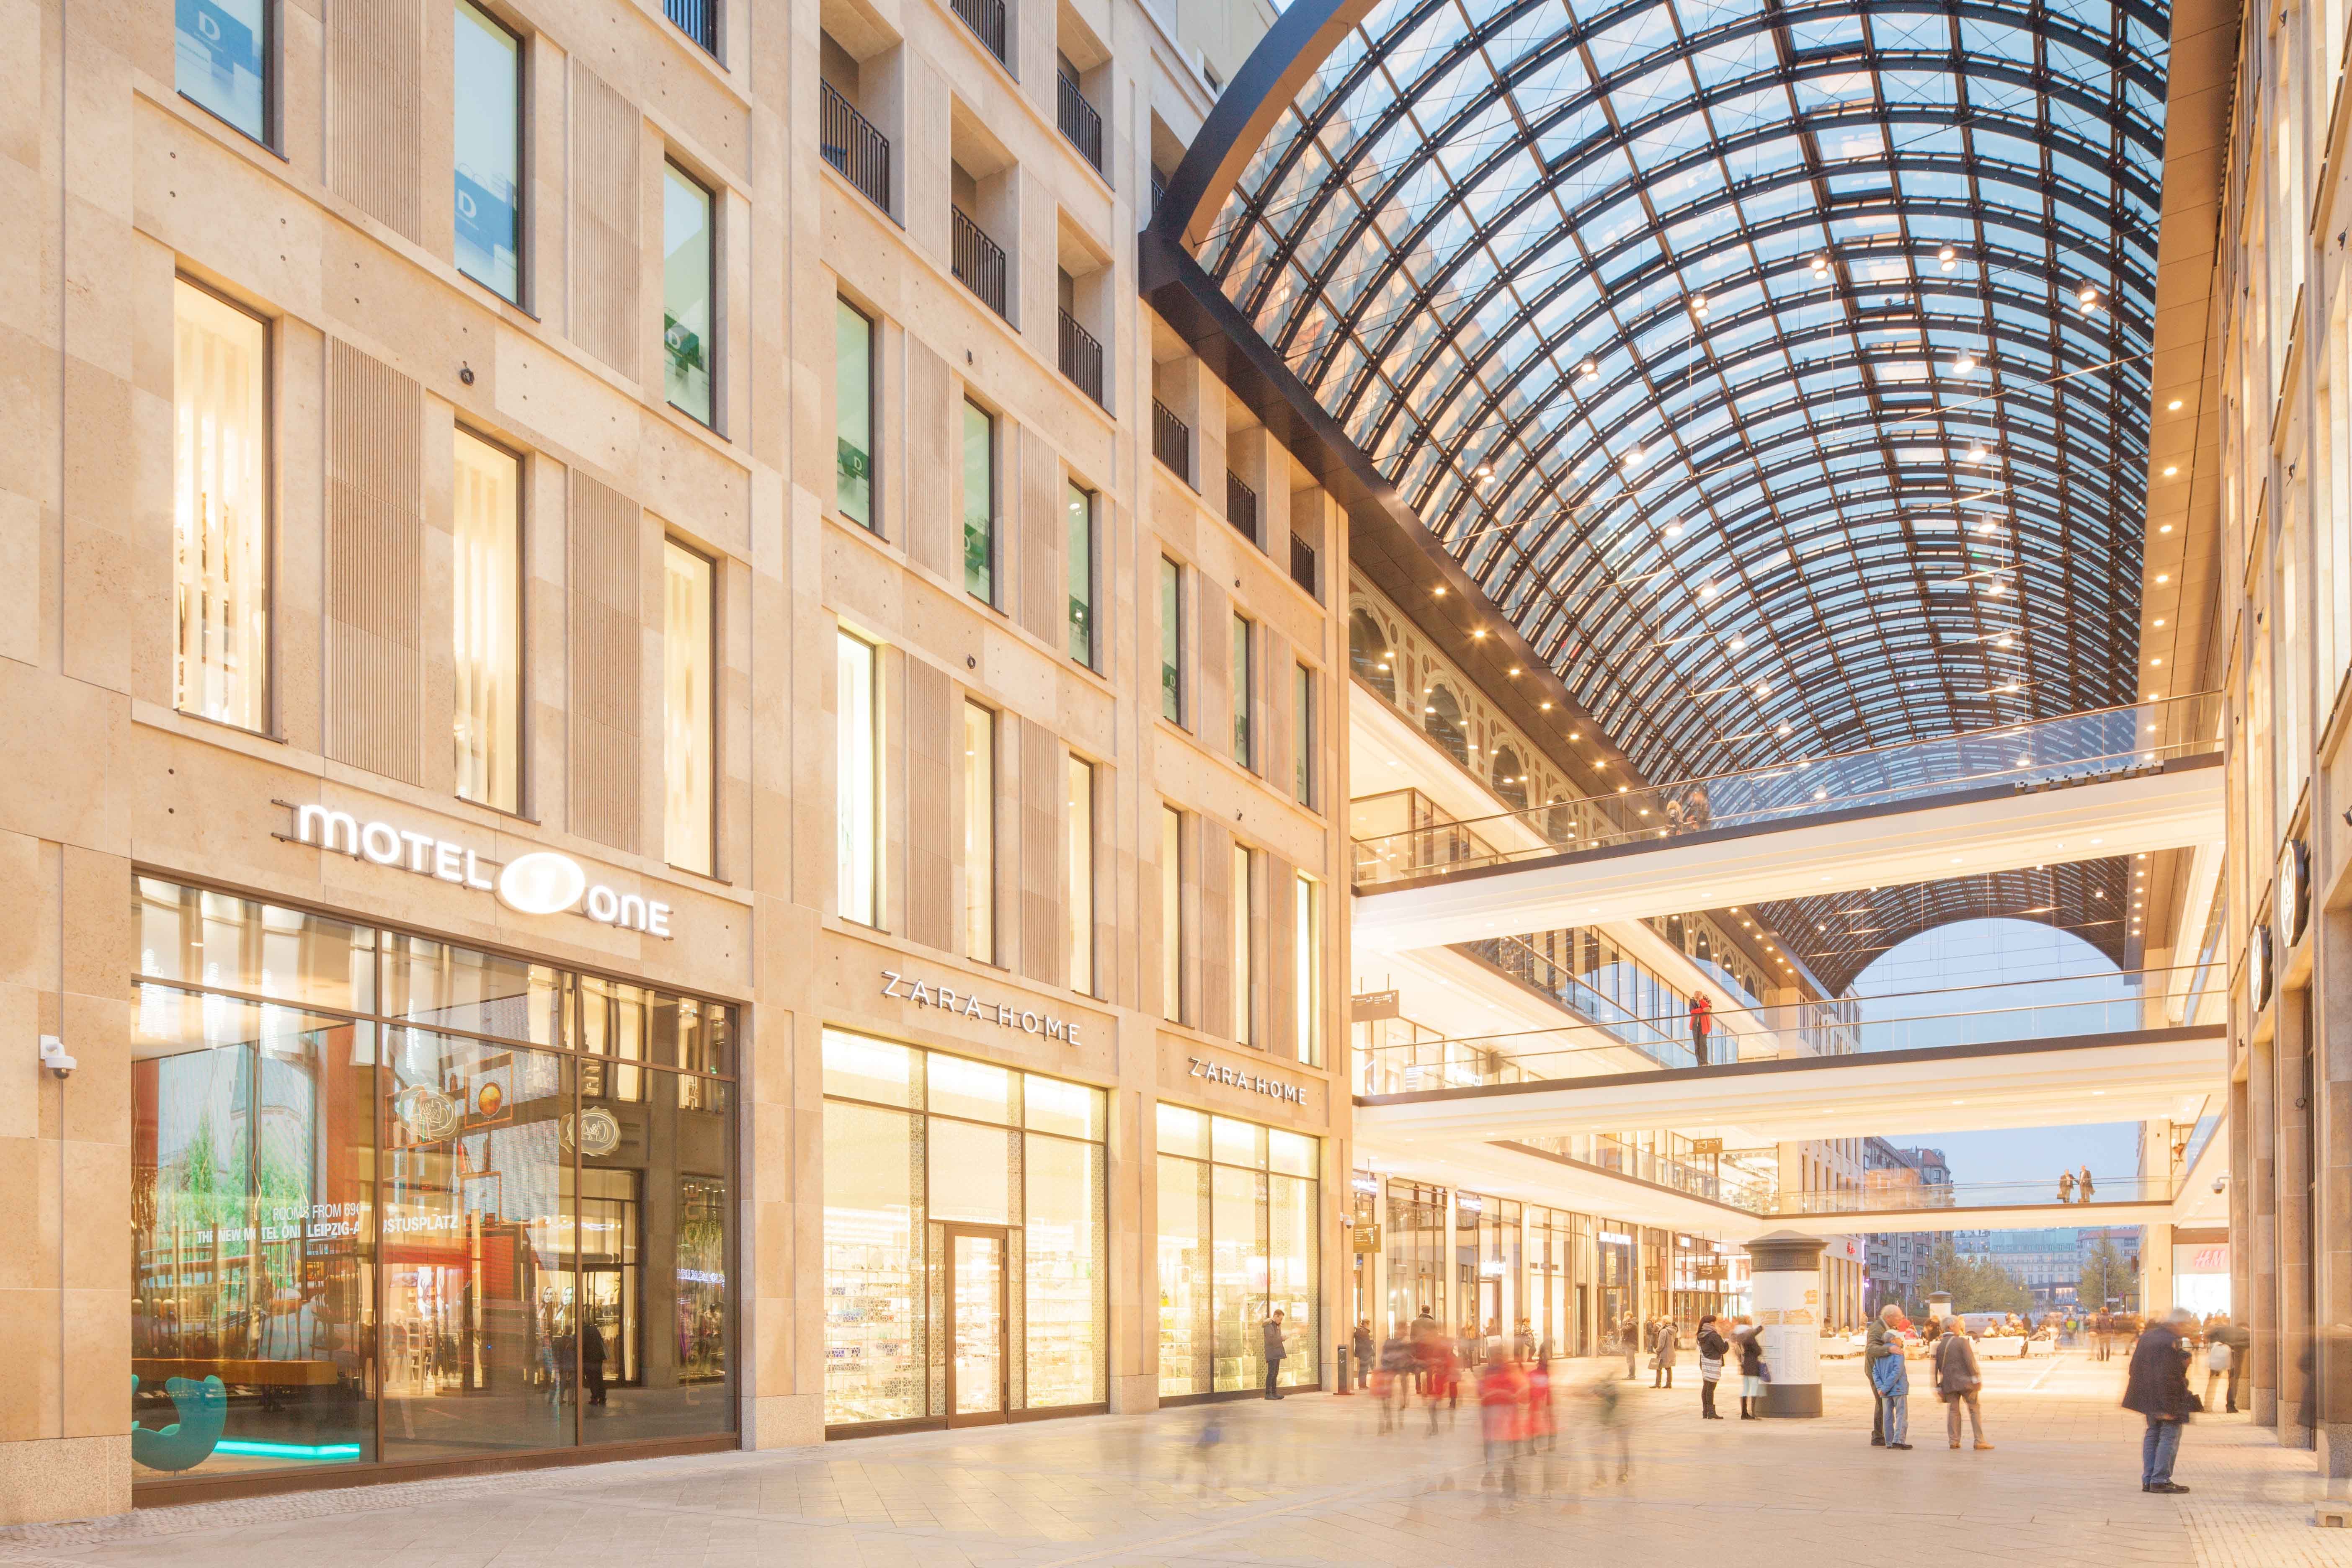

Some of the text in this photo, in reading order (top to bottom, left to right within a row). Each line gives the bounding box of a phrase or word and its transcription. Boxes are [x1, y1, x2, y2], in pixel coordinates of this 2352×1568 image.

[882, 970, 1082, 1046] ZARA HOME
[1189, 1057, 1307, 1106] ZARA HOME
[273, 1206, 309, 1220] ROOMS
[312, 1203, 341, 1219] FROM
[218, 1228, 241, 1242] NEW
